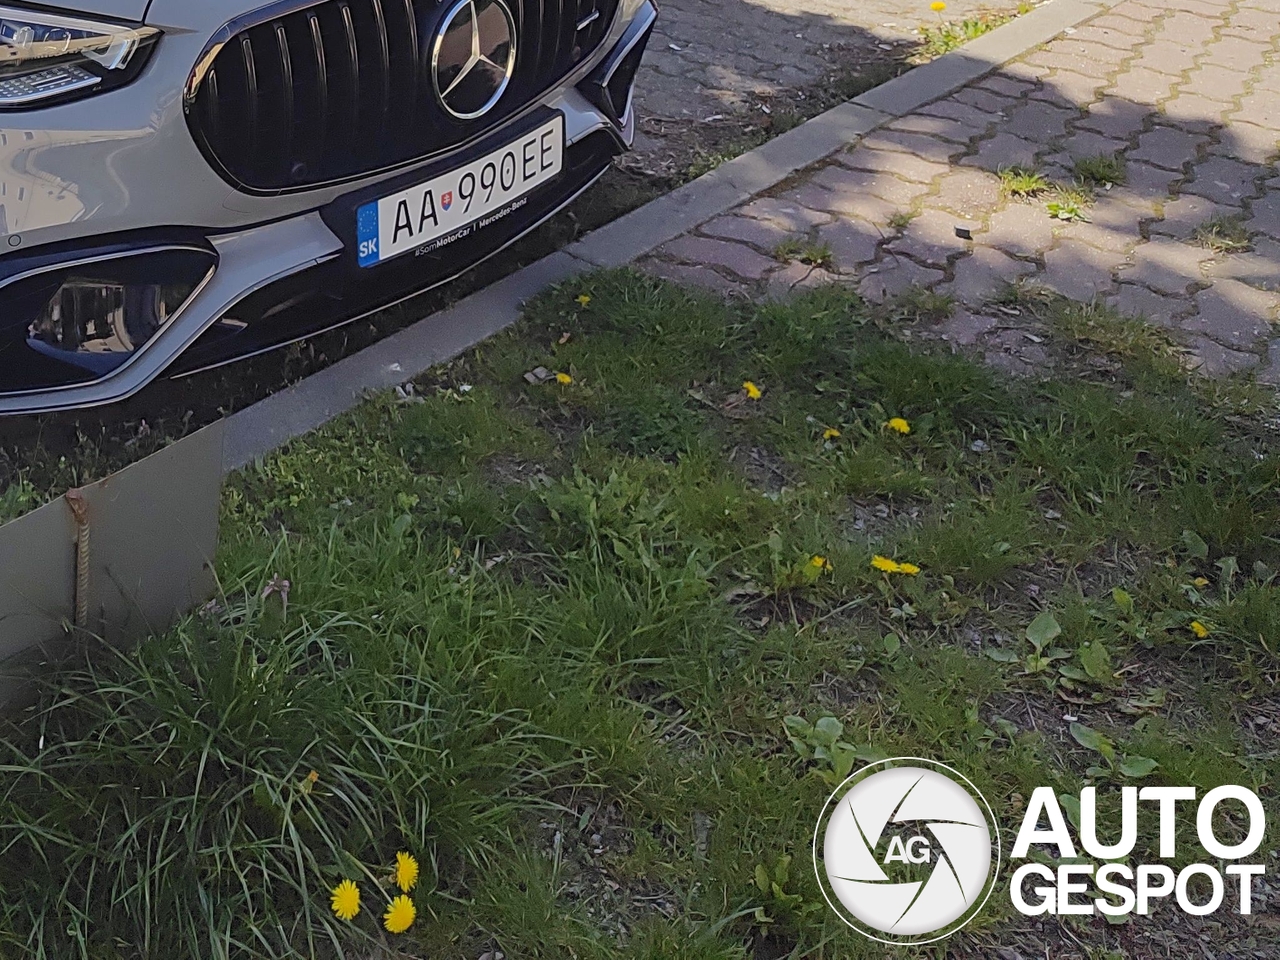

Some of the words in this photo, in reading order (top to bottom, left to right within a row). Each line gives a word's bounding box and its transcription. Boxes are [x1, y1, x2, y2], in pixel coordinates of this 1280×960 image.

[391, 189, 439, 245] AA
[458, 128, 554, 215] 990EE
[359, 237, 377, 258] SK
[414, 226, 471, 257] #SomMotorCar
[478, 197, 528, 230] Mercedes-Benz
